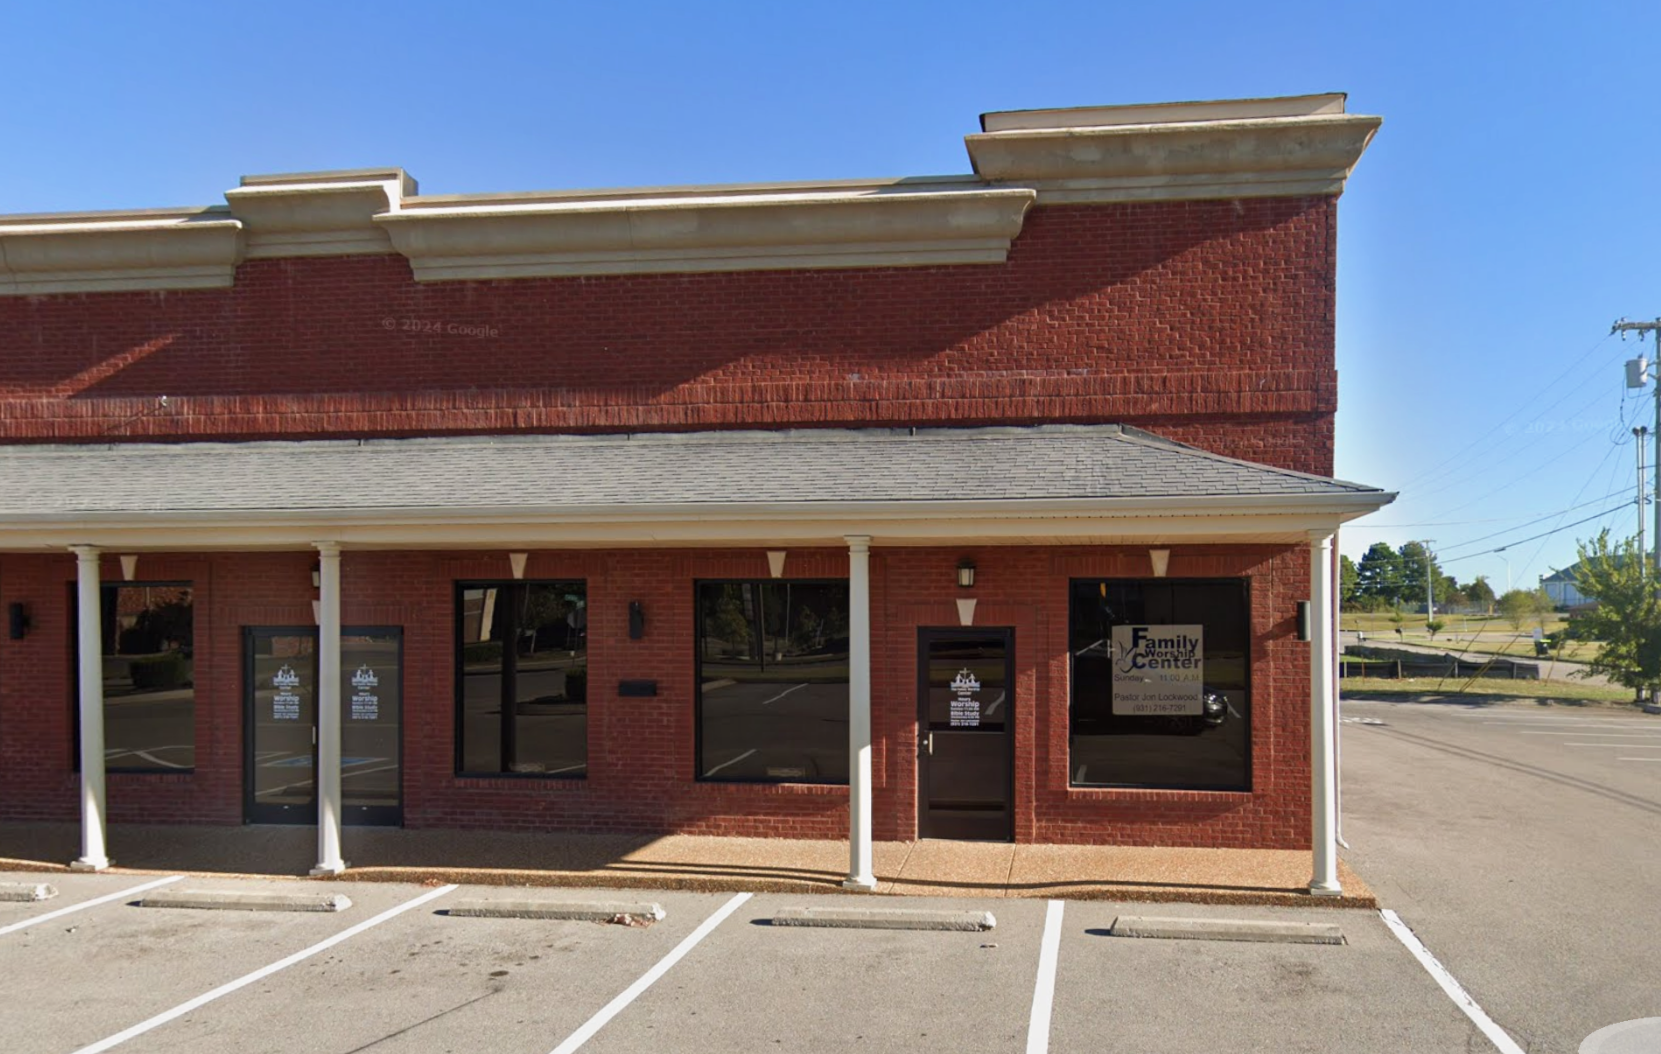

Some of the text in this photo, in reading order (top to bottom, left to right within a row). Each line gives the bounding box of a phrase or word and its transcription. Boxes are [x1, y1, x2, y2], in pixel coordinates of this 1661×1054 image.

[1132, 627, 1199, 651] Family
[1144, 648, 1196, 659] Worship
[1132, 653, 1201, 669] Center
[1114, 674, 1144, 683] Sunday
[1114, 693, 1198, 701] Pastor Jon Lockwood
